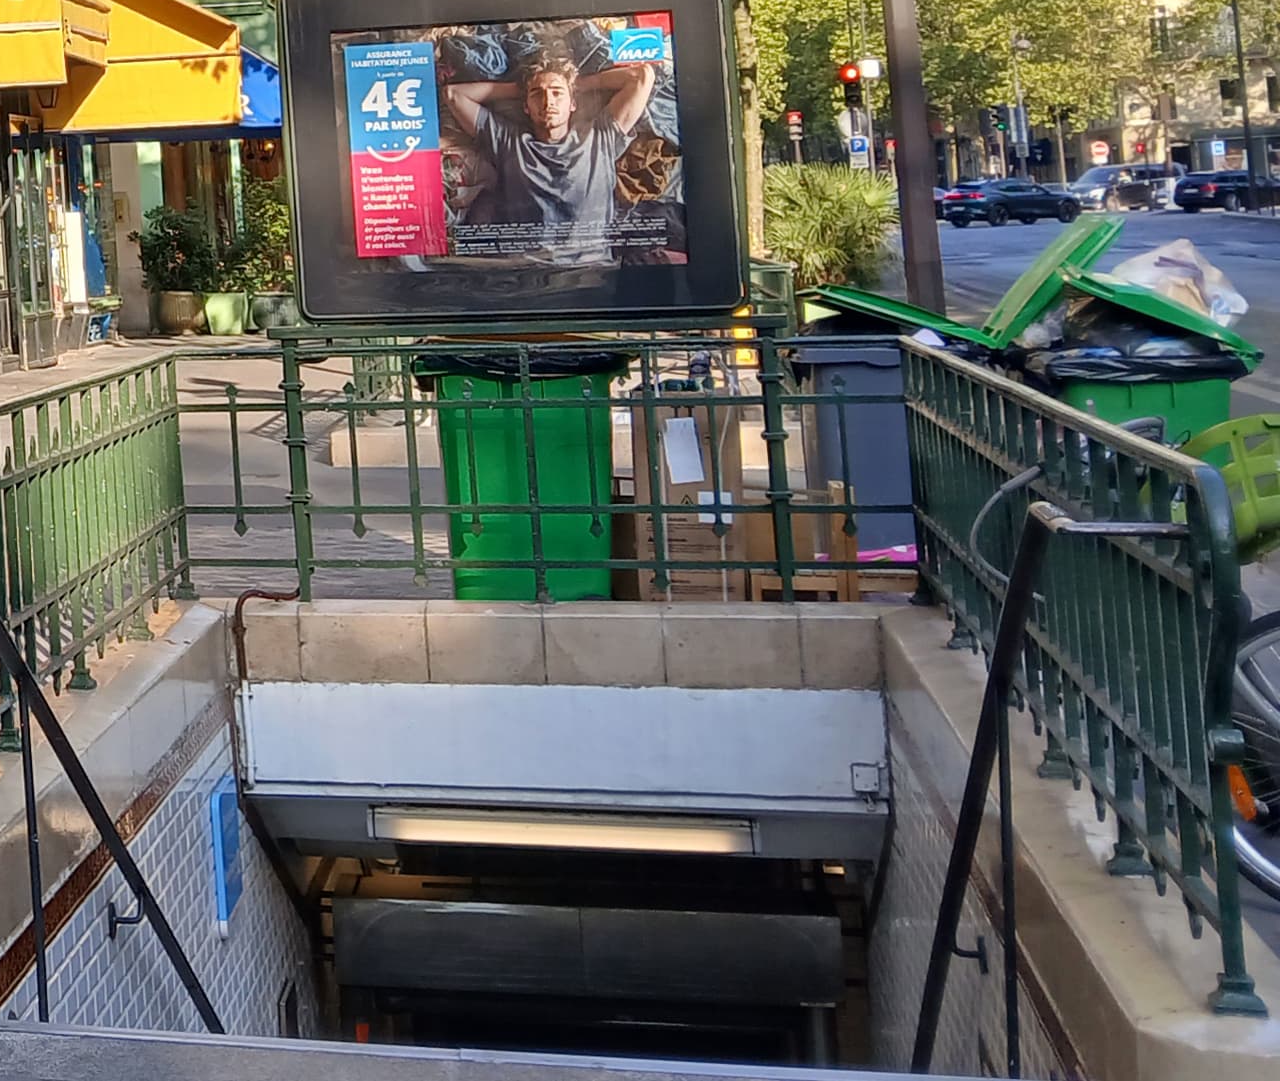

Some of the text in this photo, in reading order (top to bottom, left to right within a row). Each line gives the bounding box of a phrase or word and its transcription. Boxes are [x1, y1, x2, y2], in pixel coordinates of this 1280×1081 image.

[618, 47, 660, 60] MAAF
[361, 79, 423, 118] 4€
[365, 121, 389, 132] PAR
